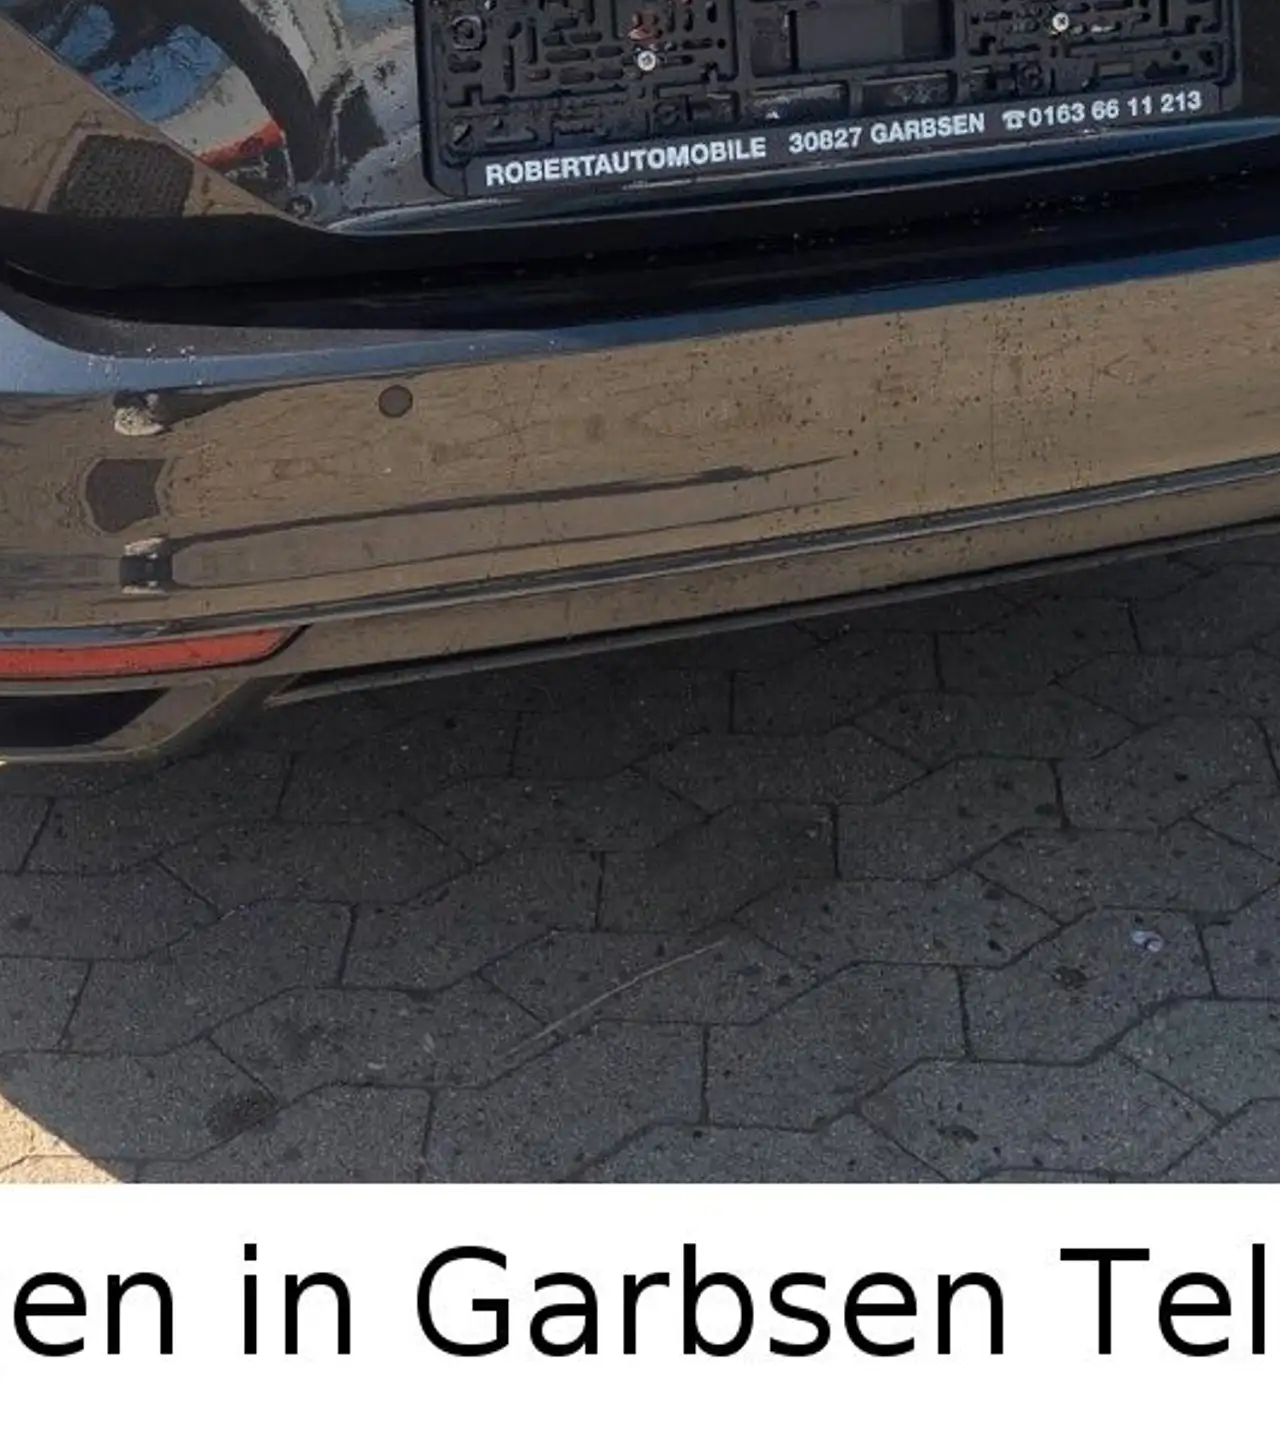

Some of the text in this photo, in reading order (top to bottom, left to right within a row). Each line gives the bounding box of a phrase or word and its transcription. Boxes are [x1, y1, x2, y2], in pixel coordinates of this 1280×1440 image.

[485, 89, 1202, 187] ROBERTAUTOMOBILE 30827 GARBSEN 0163 66 11 213
